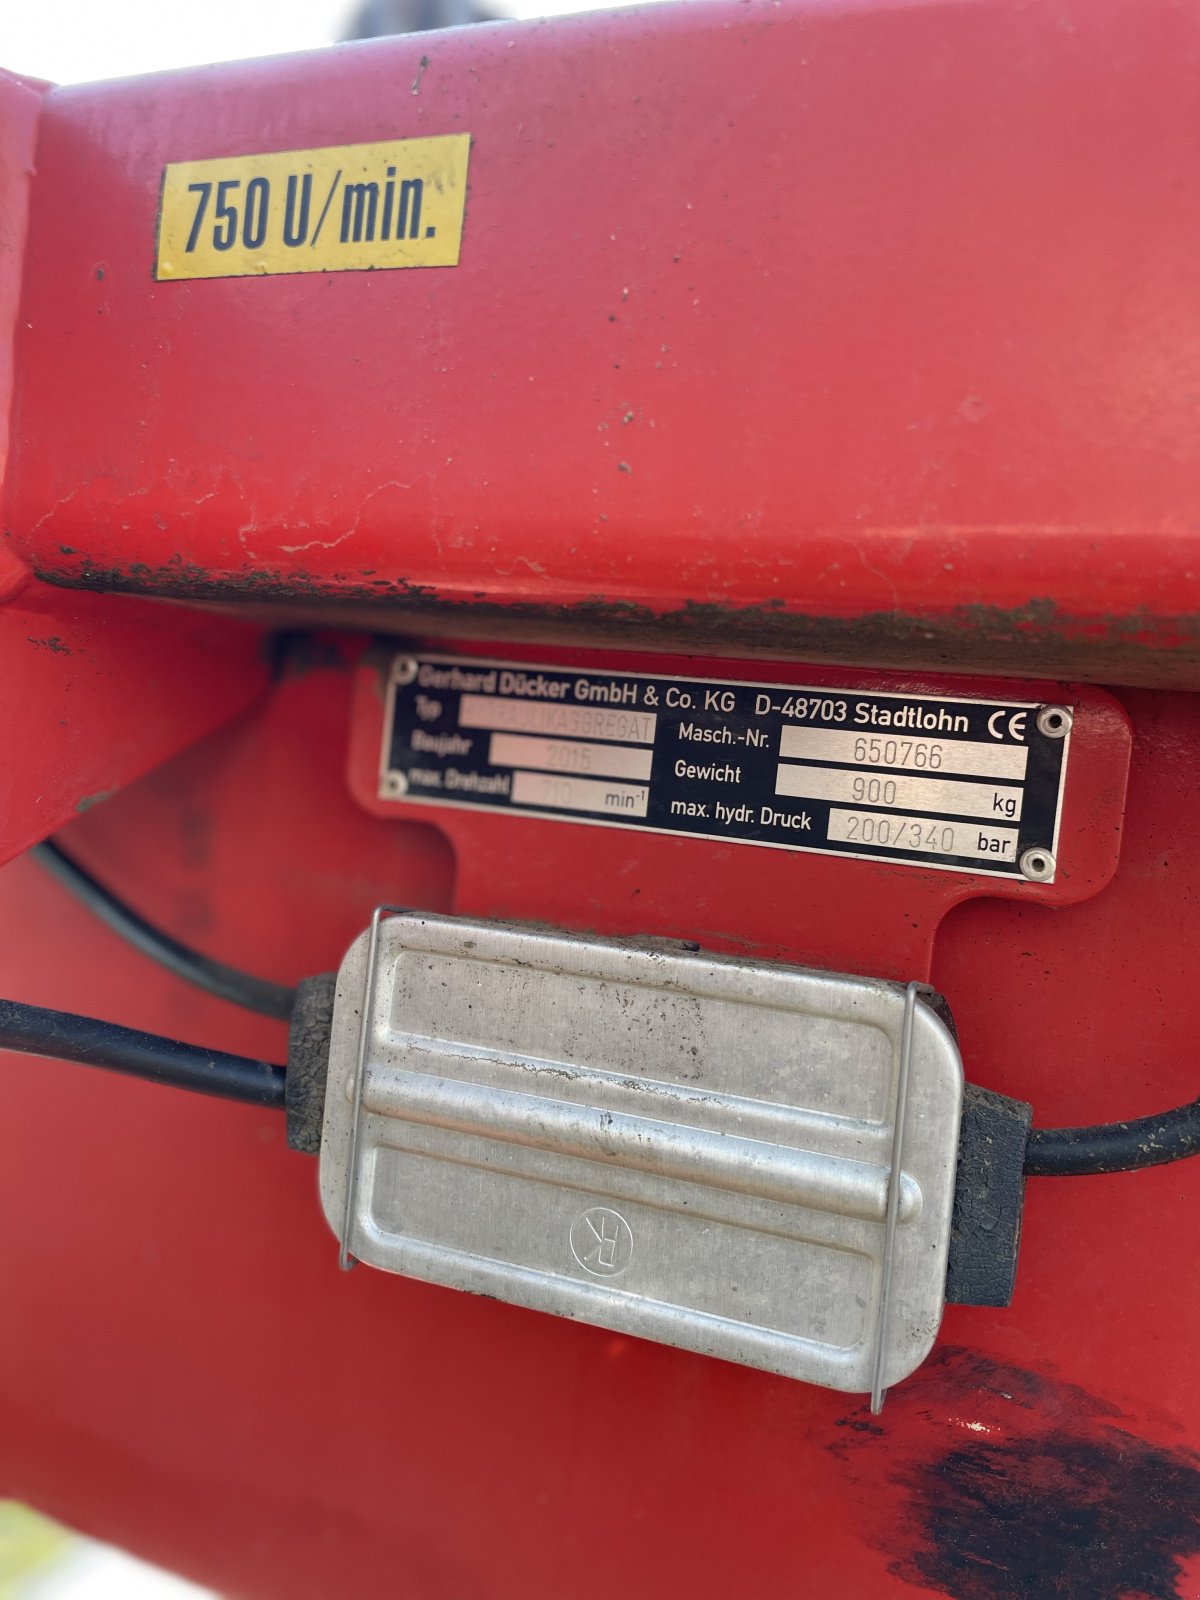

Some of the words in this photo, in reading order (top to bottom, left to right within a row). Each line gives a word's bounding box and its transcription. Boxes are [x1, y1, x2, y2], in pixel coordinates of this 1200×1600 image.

[184, 176, 271, 254] 750
[283, 165, 437, 248] U/min.
[414, 695, 443, 721] Typ
[417, 664, 497, 694] Gerhard
[499, 671, 570, 699] Dücker
[574, 678, 637, 705] GmbH
[643, 685, 659, 706] &
[665, 687, 697, 710] Co.
[704, 690, 736, 713] KG
[755, 694, 847, 722] D-48703
[853, 702, 969, 733] Stadtlohn
[411, 729, 474, 757] Baujahr
[547, 745, 592, 774] 2015
[678, 722, 770, 748] Masch.-Nr.
[854, 737, 943, 769] 650766
[444, 768, 510, 796] Drehzahl
[674, 759, 742, 784] Gewicht
[852, 777, 897, 805] 900
[992, 792, 1017, 818] kg
[670, 800, 710, 818] max.
[715, 802, 755, 825] hydr.
[760, 807, 812, 830] Druck
[846, 816, 955, 852] 200/340
[977, 832, 1012, 854] bar
